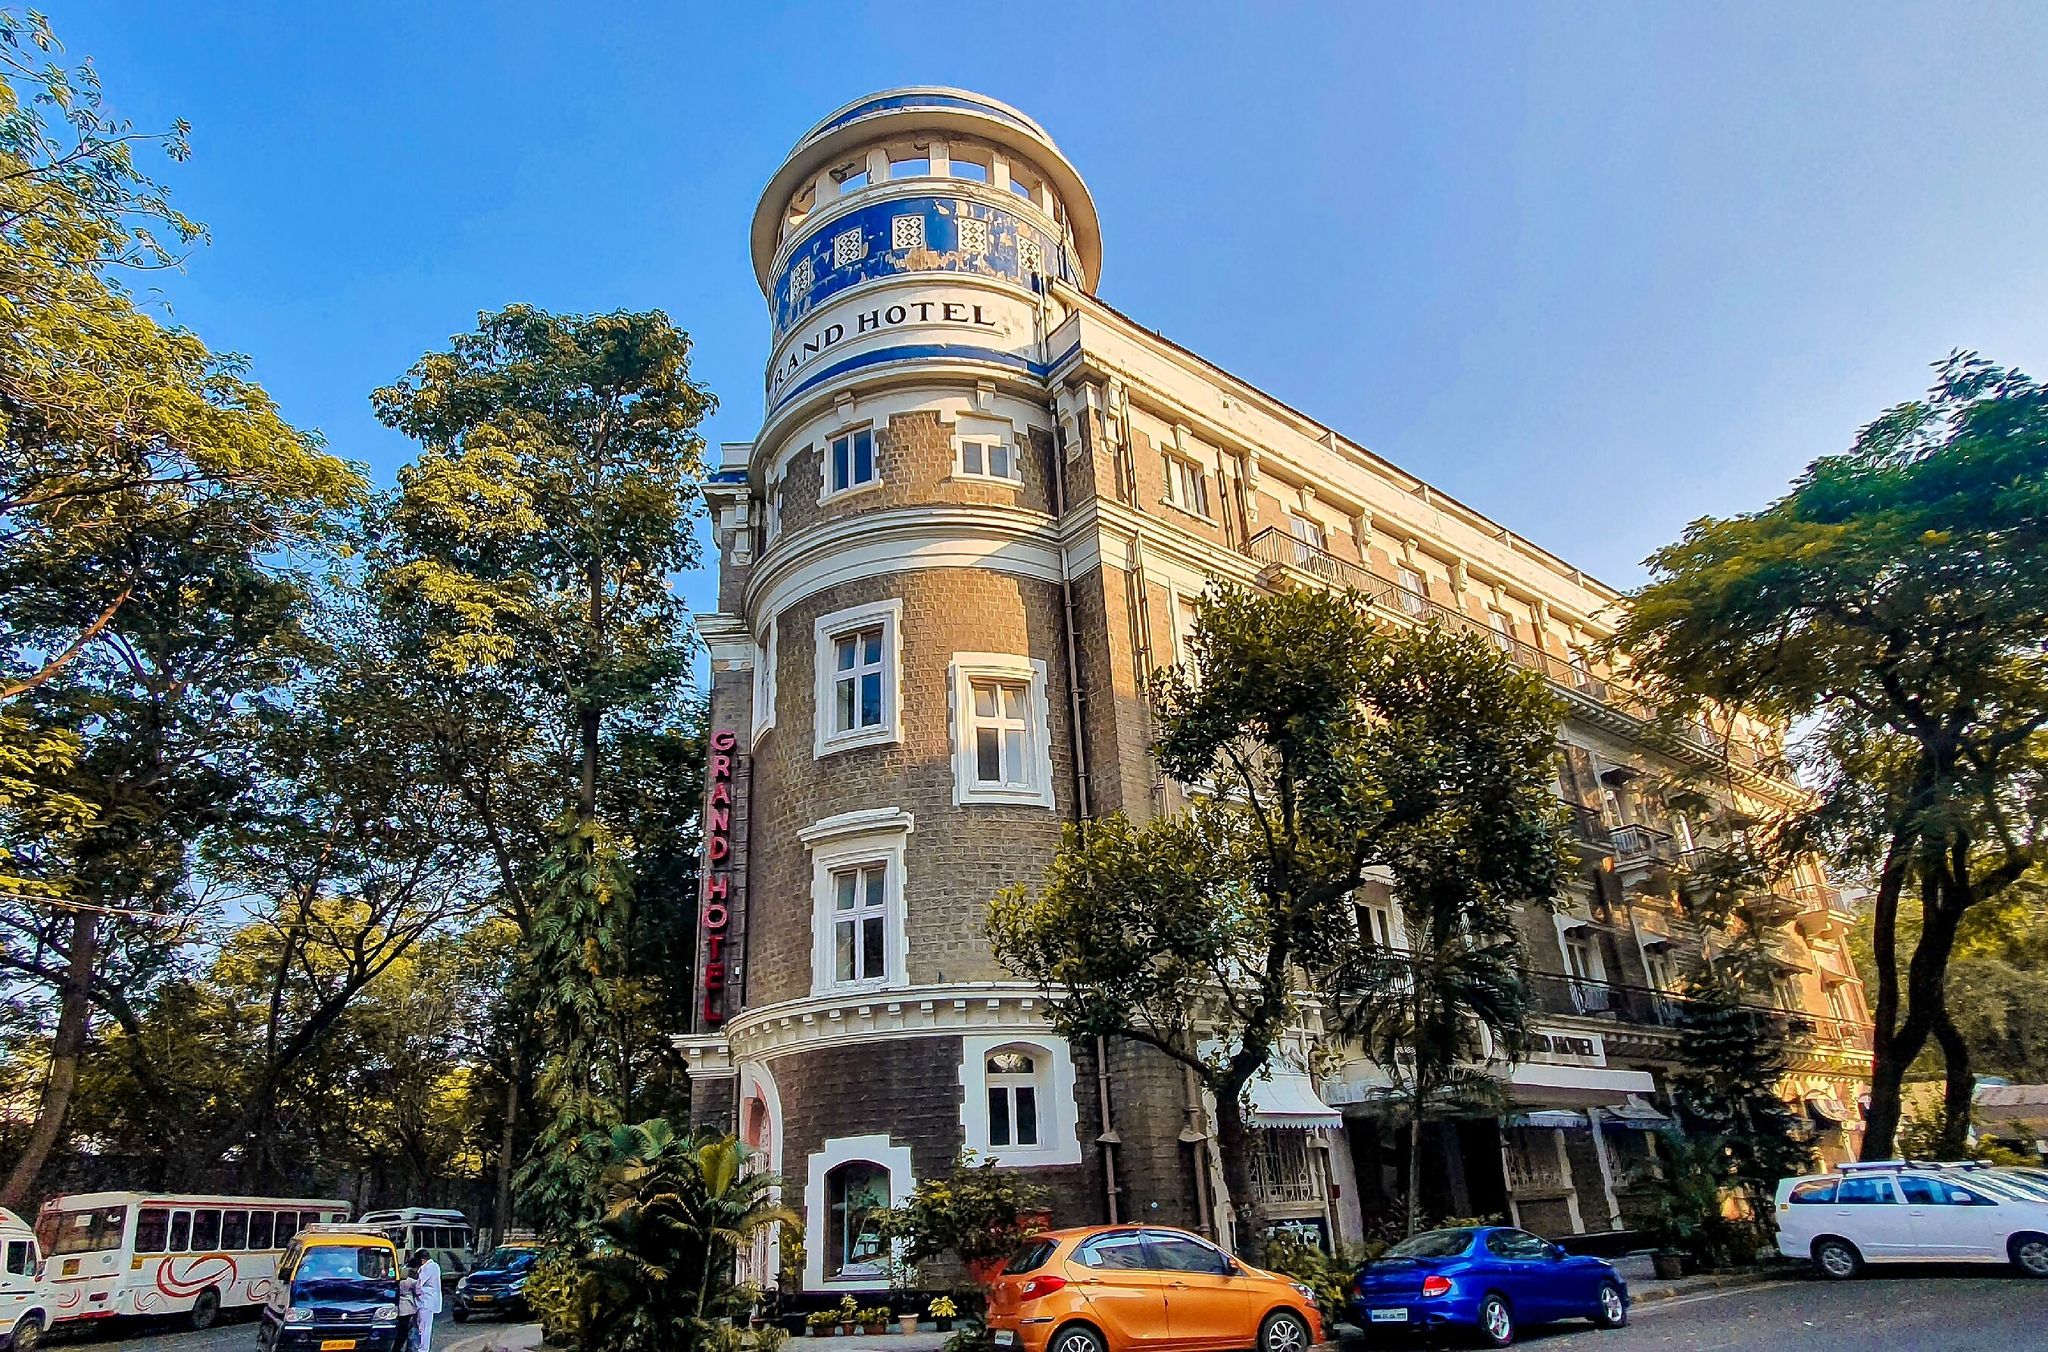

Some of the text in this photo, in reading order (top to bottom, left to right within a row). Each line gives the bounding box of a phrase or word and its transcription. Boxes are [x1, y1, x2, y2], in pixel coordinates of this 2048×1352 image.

[774, 301, 996, 393] RAND HOTEL
[702, 728, 737, 1022] GRAND HOTEL
